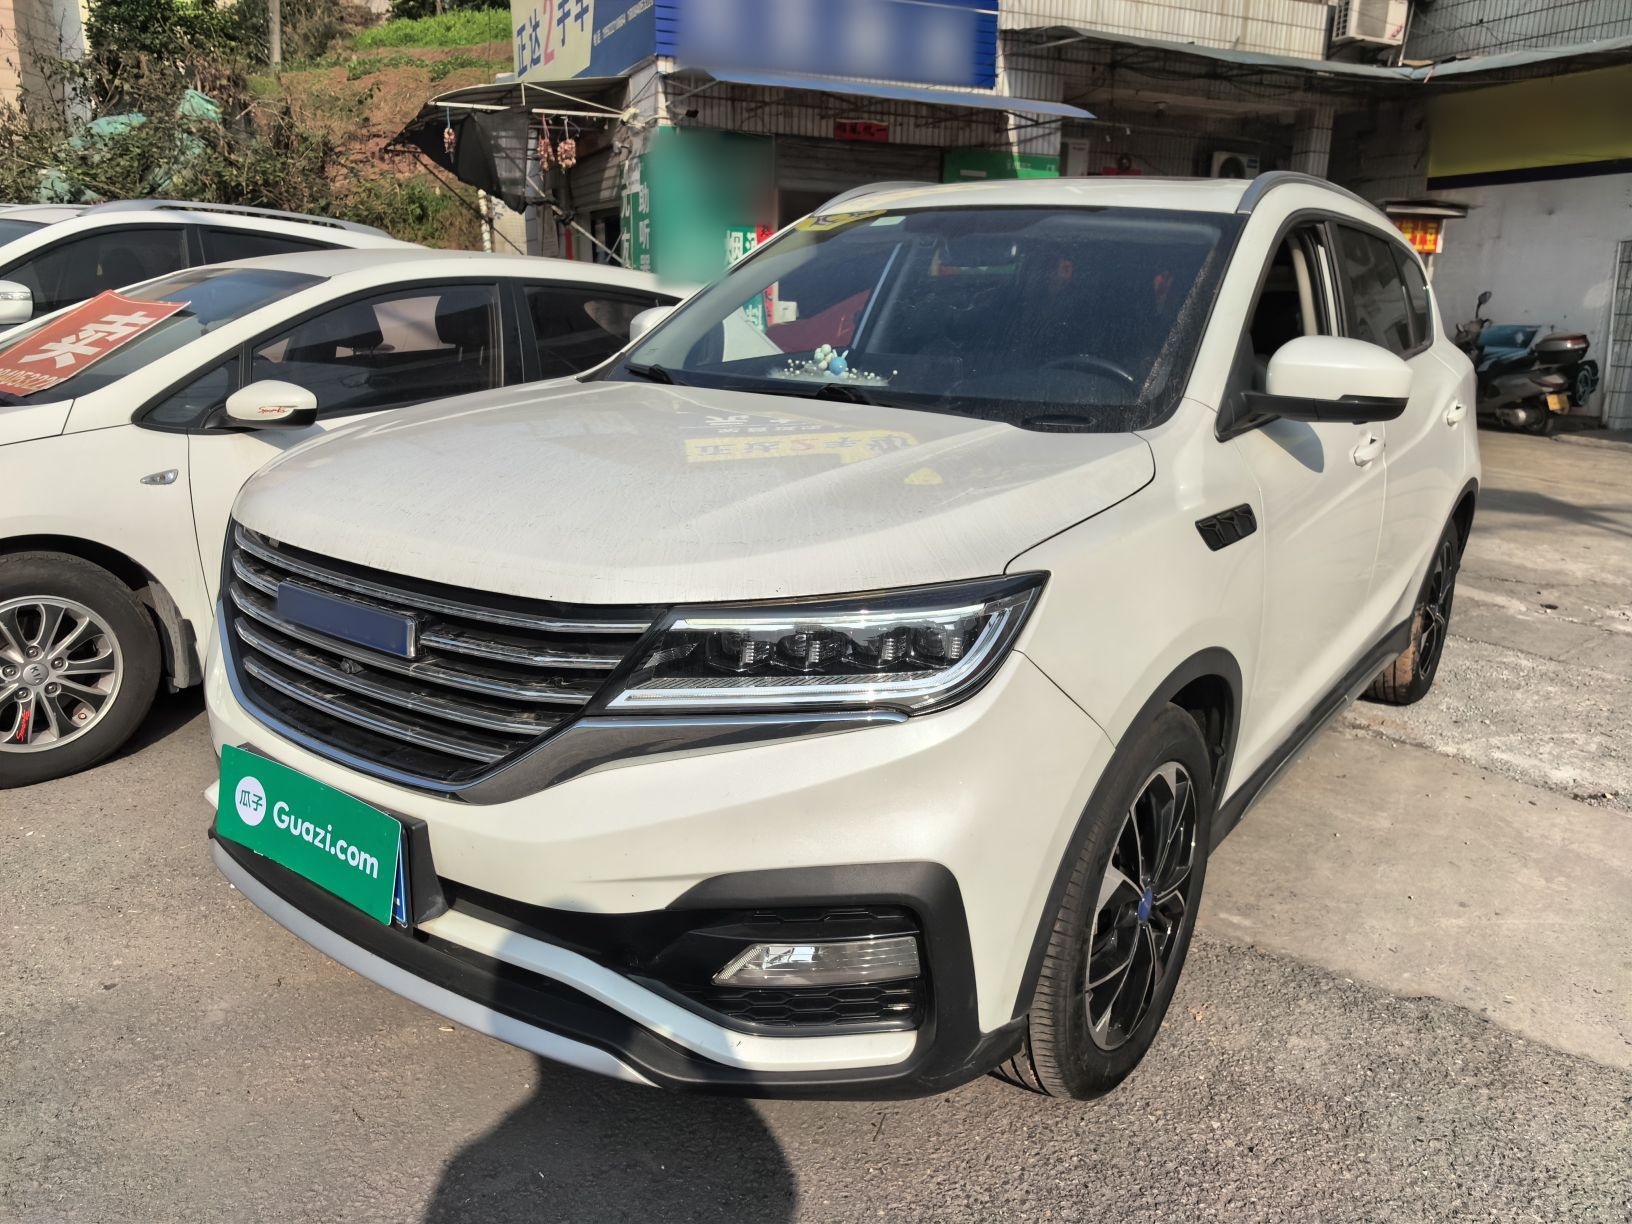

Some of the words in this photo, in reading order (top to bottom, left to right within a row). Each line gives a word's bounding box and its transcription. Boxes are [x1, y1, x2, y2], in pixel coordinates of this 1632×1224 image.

[18, 311, 157, 369] 卖
[239, 789, 263, 812] 瓜子
[272, 801, 379, 879] Guazi.com
